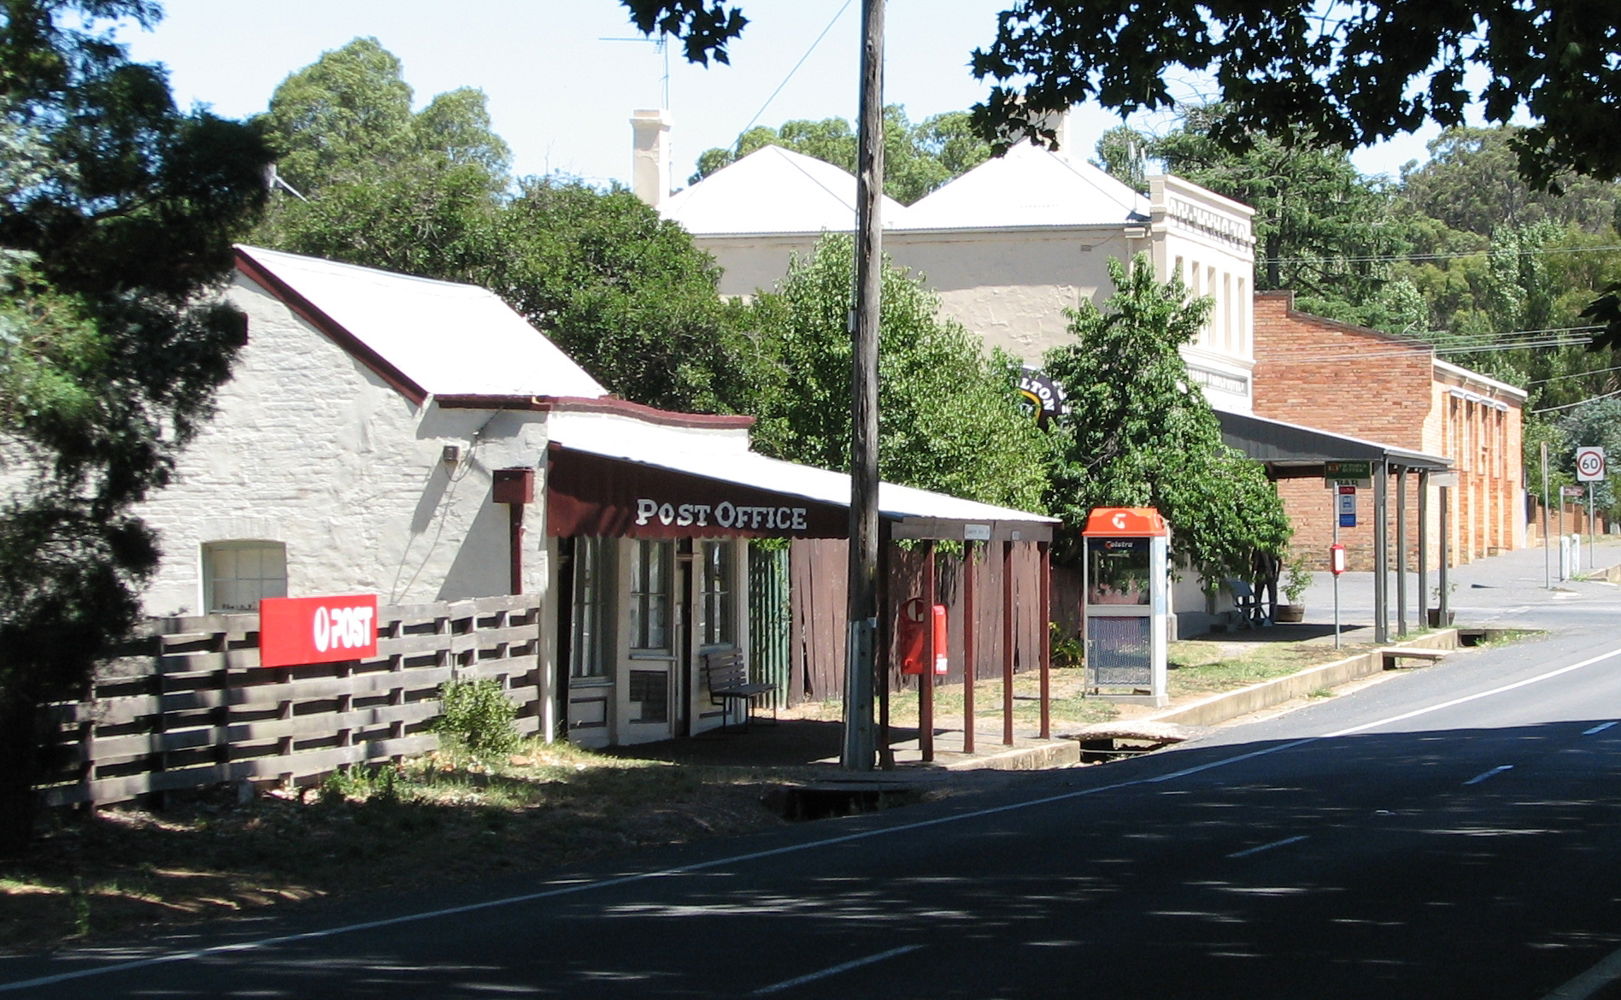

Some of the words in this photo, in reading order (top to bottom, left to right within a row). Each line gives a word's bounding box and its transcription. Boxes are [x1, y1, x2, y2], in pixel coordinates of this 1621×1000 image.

[1020, 377, 1055, 411] LTON
[1582, 458, 1599, 470] 60
[635, 499, 711, 527] POST
[714, 501, 807, 530] OFFICE
[330, 606, 373, 649] POST
